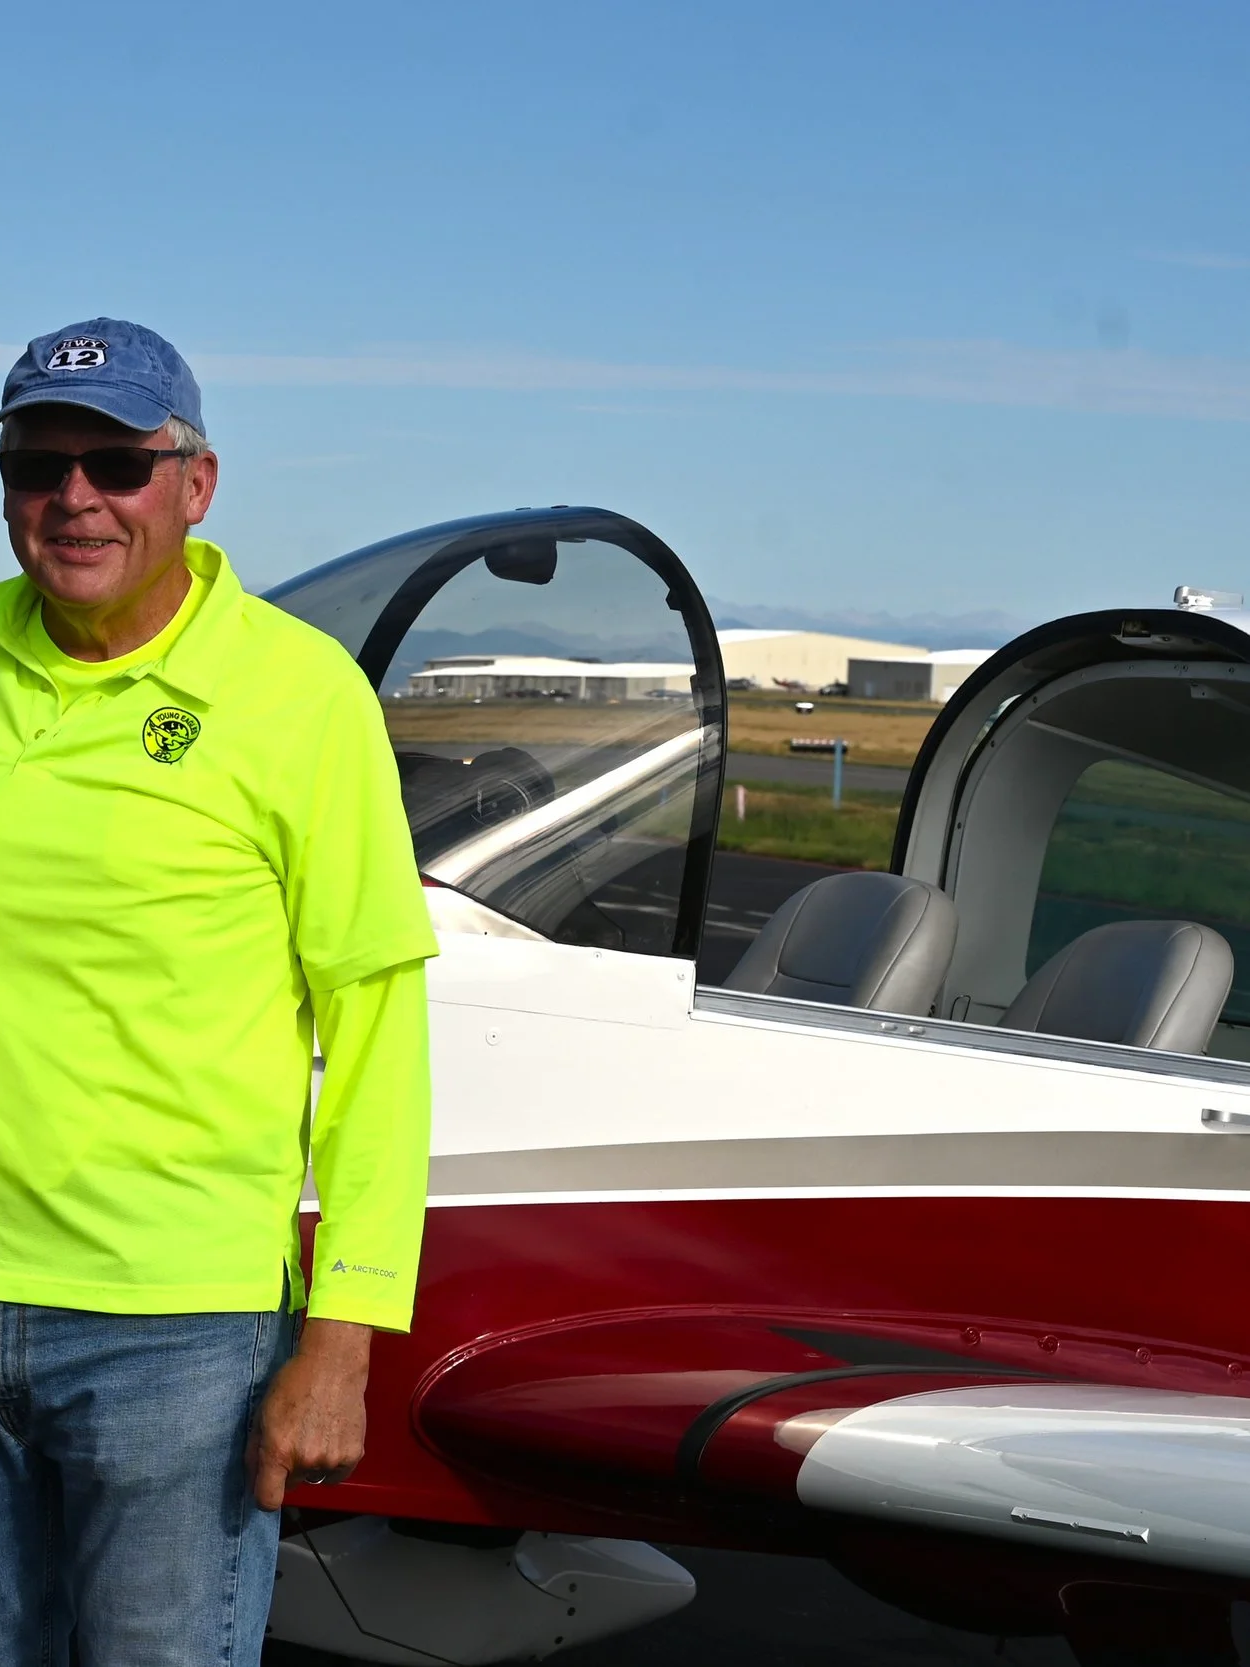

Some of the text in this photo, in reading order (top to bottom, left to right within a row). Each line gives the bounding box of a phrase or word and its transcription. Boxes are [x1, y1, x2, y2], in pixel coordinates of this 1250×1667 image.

[60, 339, 101, 350] HWY
[52, 350, 99, 368] 12
[155, 711, 180, 722] YOUNG
[351, 1264, 379, 1276] ARCTIC
